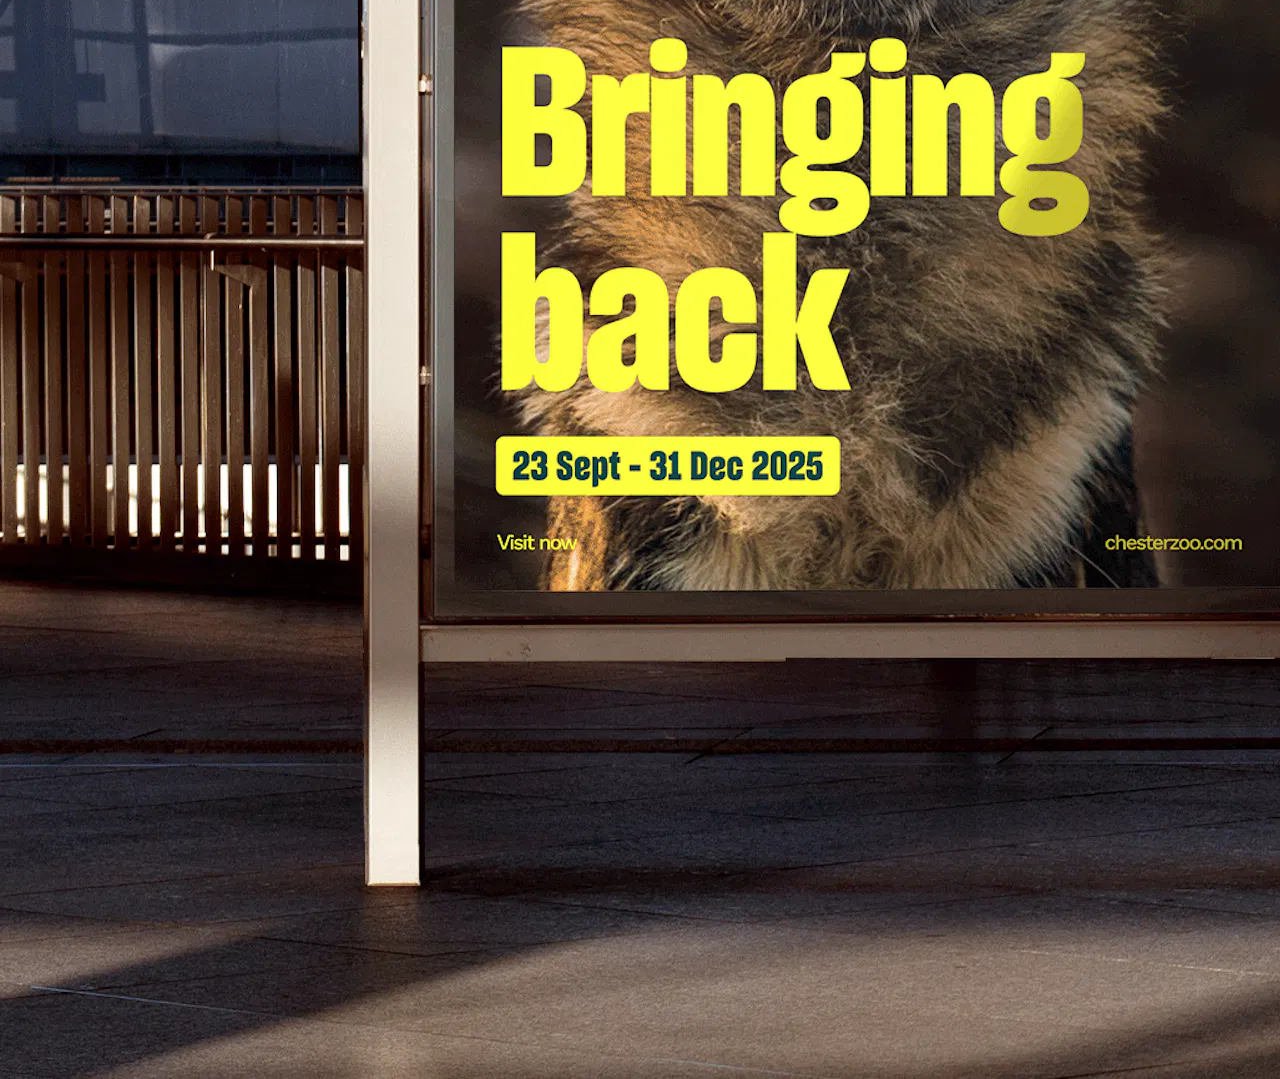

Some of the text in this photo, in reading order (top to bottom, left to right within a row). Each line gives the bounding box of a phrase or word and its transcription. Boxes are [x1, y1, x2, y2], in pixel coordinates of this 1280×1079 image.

[501, 37, 1090, 237] Bringing
[501, 232, 851, 393] back
[512, 450, 548, 481] 23
[556, 450, 621, 487] Sept
[649, 450, 682, 481] 31
[690, 451, 744, 481] Dec
[752, 450, 823, 481] 2025
[497, 533, 578, 551] Visit now
[1105, 534, 1243, 551] chesterzoo.com
